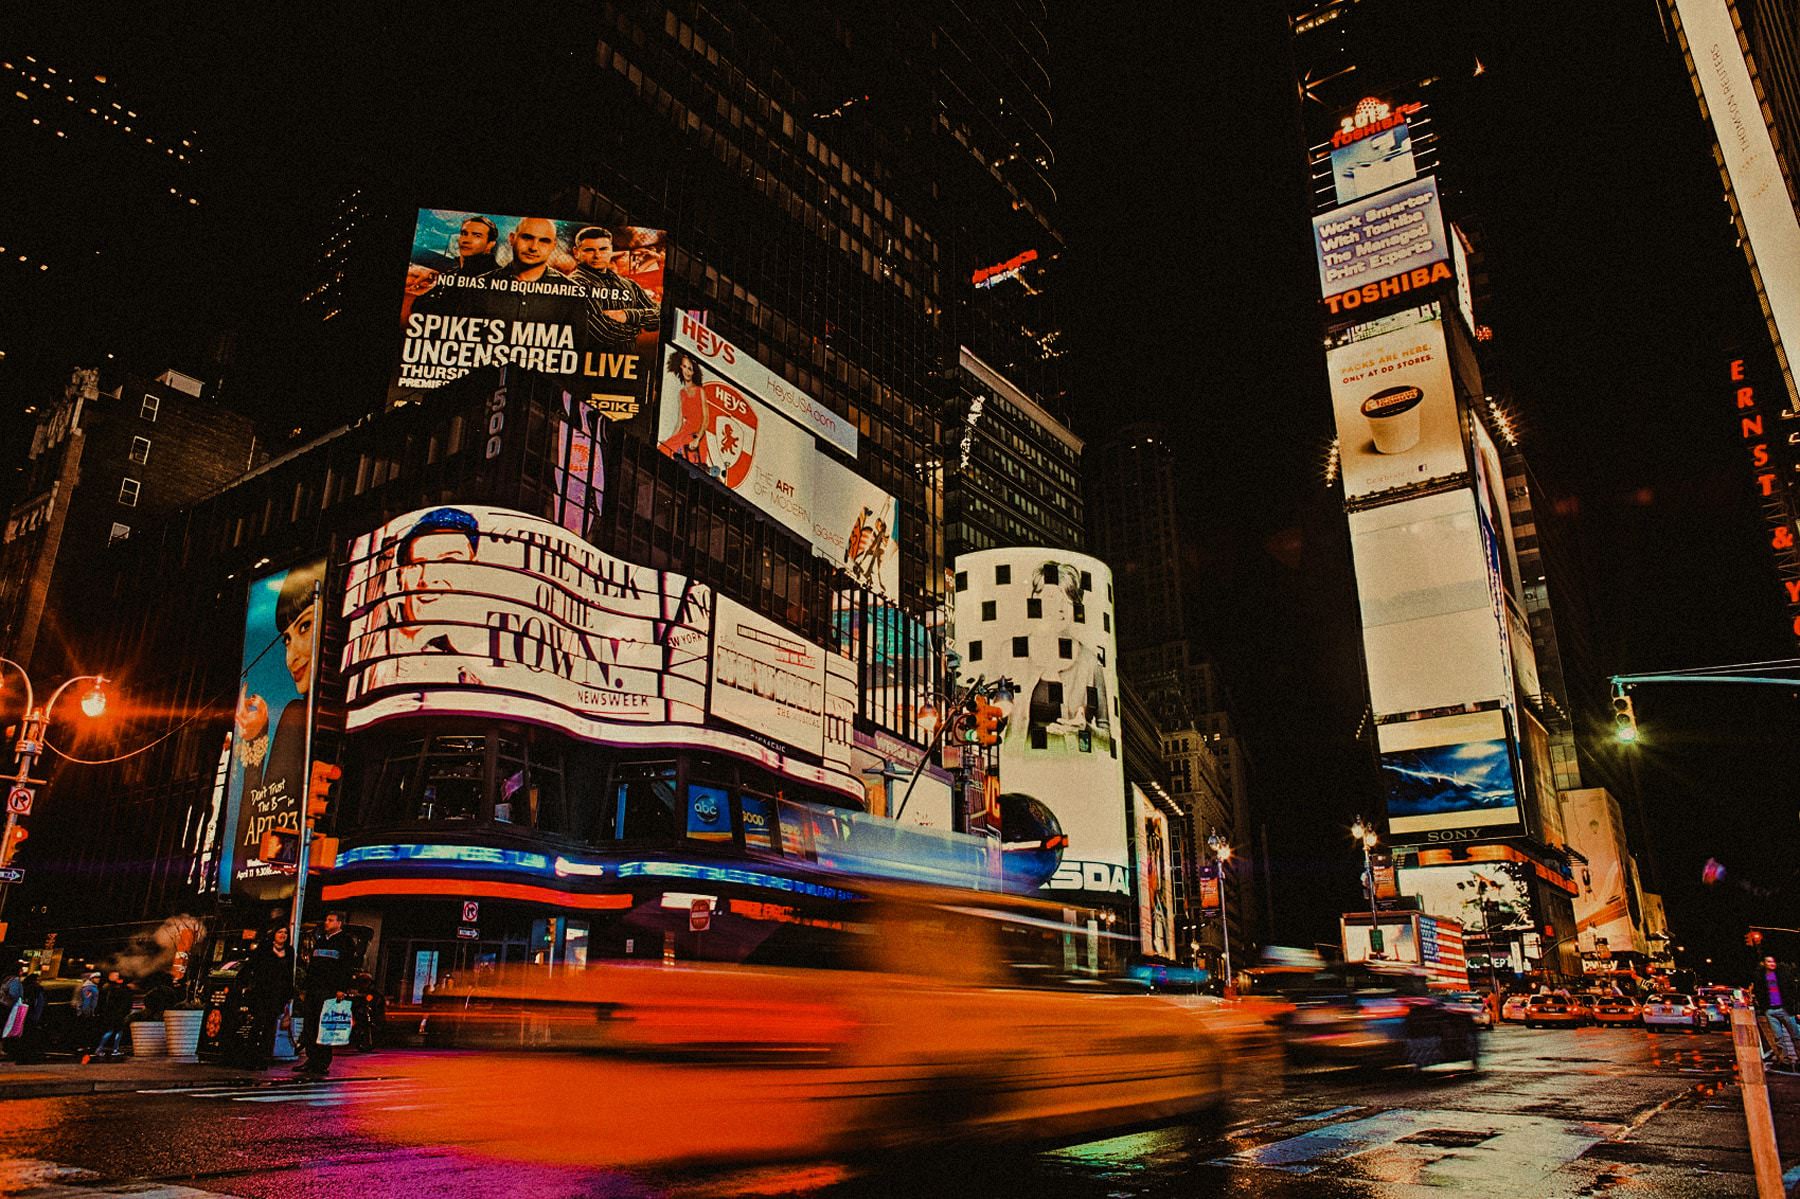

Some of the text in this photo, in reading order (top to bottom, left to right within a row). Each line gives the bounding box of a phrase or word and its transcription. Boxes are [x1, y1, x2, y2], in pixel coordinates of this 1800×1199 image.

[1711, 43, 1749, 152] THOMSON REUTERS
[1330, 111, 1405, 148] TOSHIBA
[1320, 192, 1434, 238] Work Smarter
[1321, 211, 1424, 252] With Toshiba
[1323, 223, 1429, 266] The Managed
[1326, 240, 1434, 282] Print Experts
[437, 274, 633, 302] NO BIAS. NO BOUNDARIES. NO B.S.
[1325, 262, 1452, 314] TOSHIBA
[406, 313, 574, 349] SPIKE'S MMA
[402, 338, 640, 380] UNCENSORED LIVE
[1342, 374, 1365, 384] ONLY
[1368, 369, 1378, 377] AT
[1397, 354, 1435, 369] STORES.
[1730, 359, 1776, 496] ERNST
[755, 465, 795, 498] THE ART
[753, 481, 768, 496] OF
[770, 491, 811, 524] MODERN
[1771, 526, 1794, 549] &
[268, 778, 286, 795] Trust
[258, 801, 270, 812] The
[694, 801, 717, 818] abc
[1427, 828, 1481, 842] SONY
